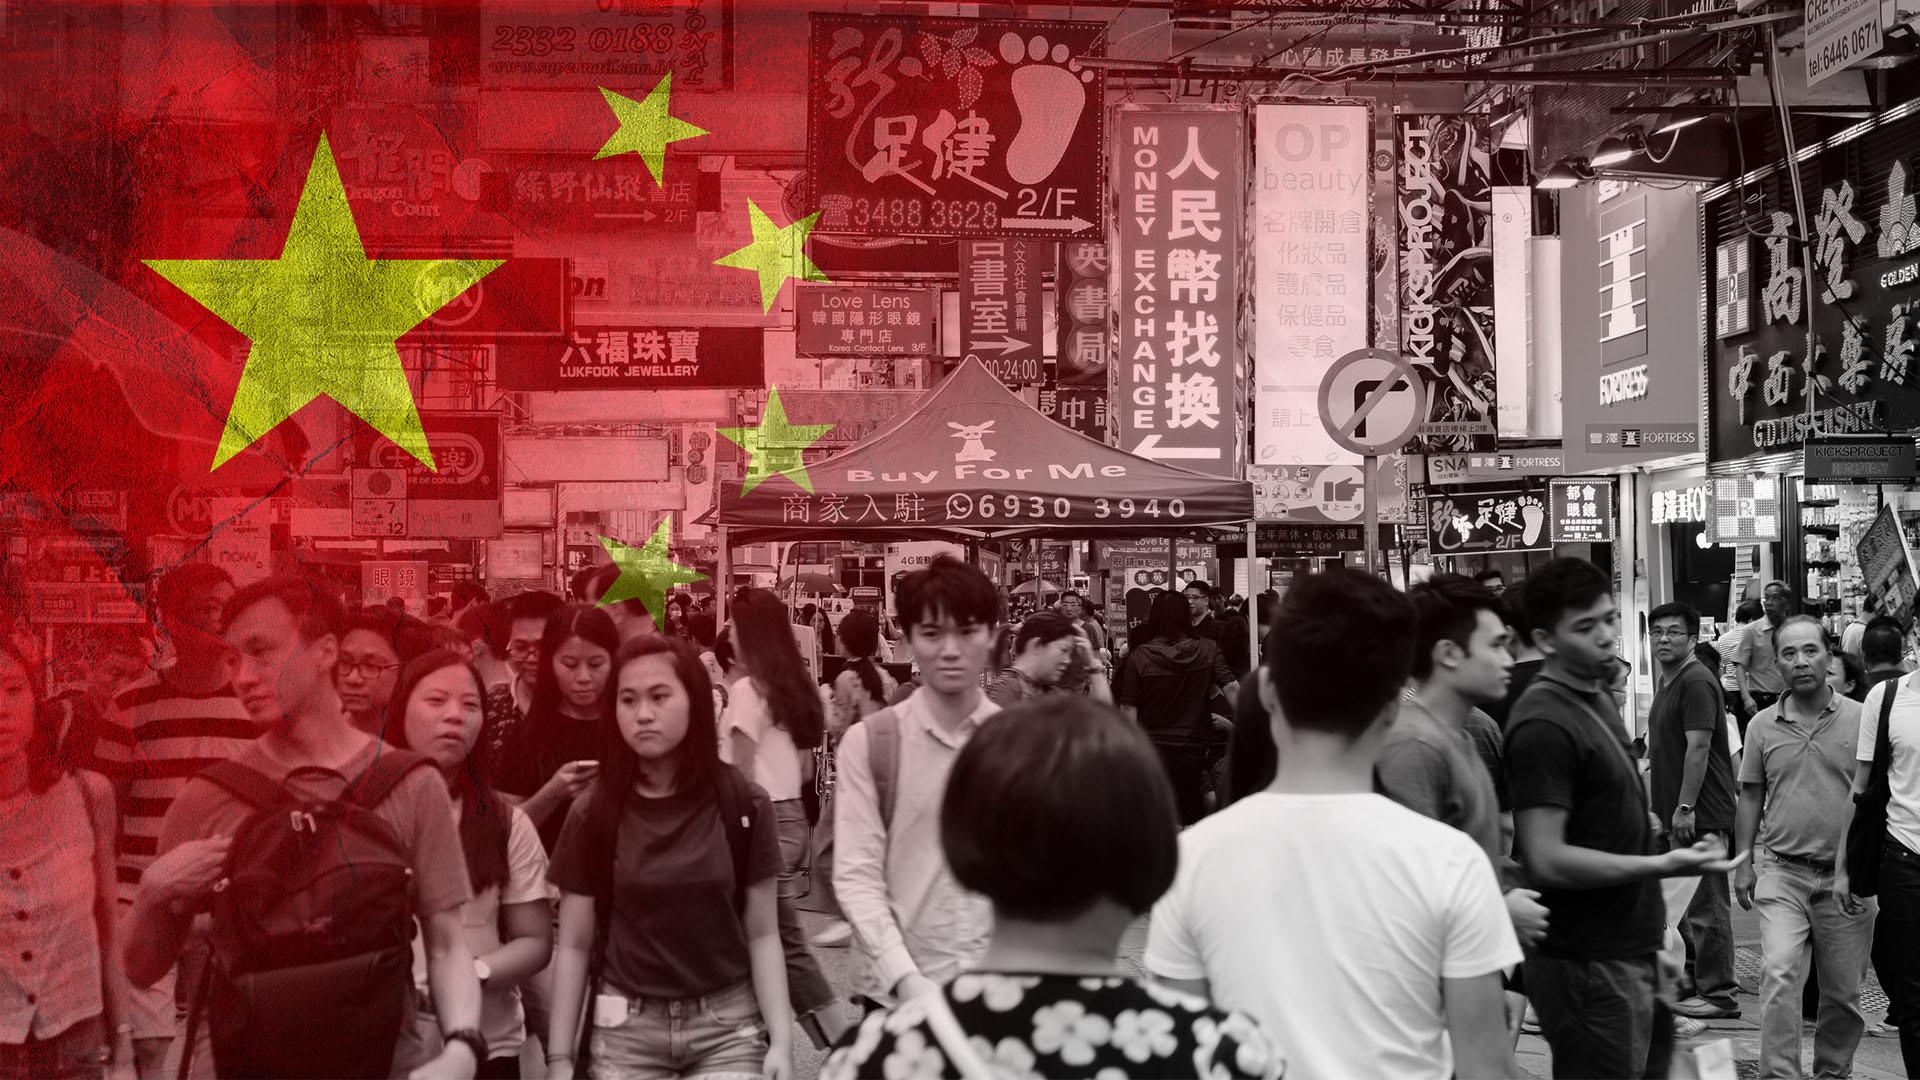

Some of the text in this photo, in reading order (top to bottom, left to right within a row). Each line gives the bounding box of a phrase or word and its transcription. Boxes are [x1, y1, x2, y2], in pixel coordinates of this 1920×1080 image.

[491, 22, 676, 57] 2332 0188
[1851, 18, 1878, 55] 0671
[1275, 123, 1351, 162] OP
[1133, 126, 1159, 236] MONEY
[1263, 166, 1363, 197] beauty
[391, 200, 441, 218] Court
[854, 198, 998, 229] 3488 3628
[1016, 187, 1078, 217] 2/F
[664, 209, 689, 223] 2/F
[1262, 209, 1363, 235] 名牌開倉
[1165, 126, 1222, 430] 人民幣找換
[1277, 272, 1348, 297] 護膚品
[1880, 262, 1919, 289] GOLDEN
[820, 294, 911, 308] Love Lens
[811, 310, 921, 327] 韓國隱形眼鏡
[1278, 303, 1347, 328] 保健品
[559, 330, 701, 365] 六福珠寶
[828, 343, 927, 353] Korea Contact Lens 3/F
[840, 329, 893, 344] 專門店
[1132, 249, 1157, 429] EXCHANGE
[1287, 334, 1336, 359] 零食
[559, 365, 701, 378] LUKFOOK JEWELLERY
[1643, 432, 1696, 444] FORTRESS
[1516, 457, 1561, 467] FORTRESS
[1814, 446, 1905, 458] KICKSPROJECT
[846, 462, 1127, 485] Buy For Me
[387, 501, 396, 514] 7
[782, 492, 1187, 525] 商家入駐 6930 3940
[388, 522, 404, 534] 12
[1495, 534, 1521, 549] 2/F
[374, 568, 416, 587] 眼鏡
[1025, 561, 1060, 570] 永士多
